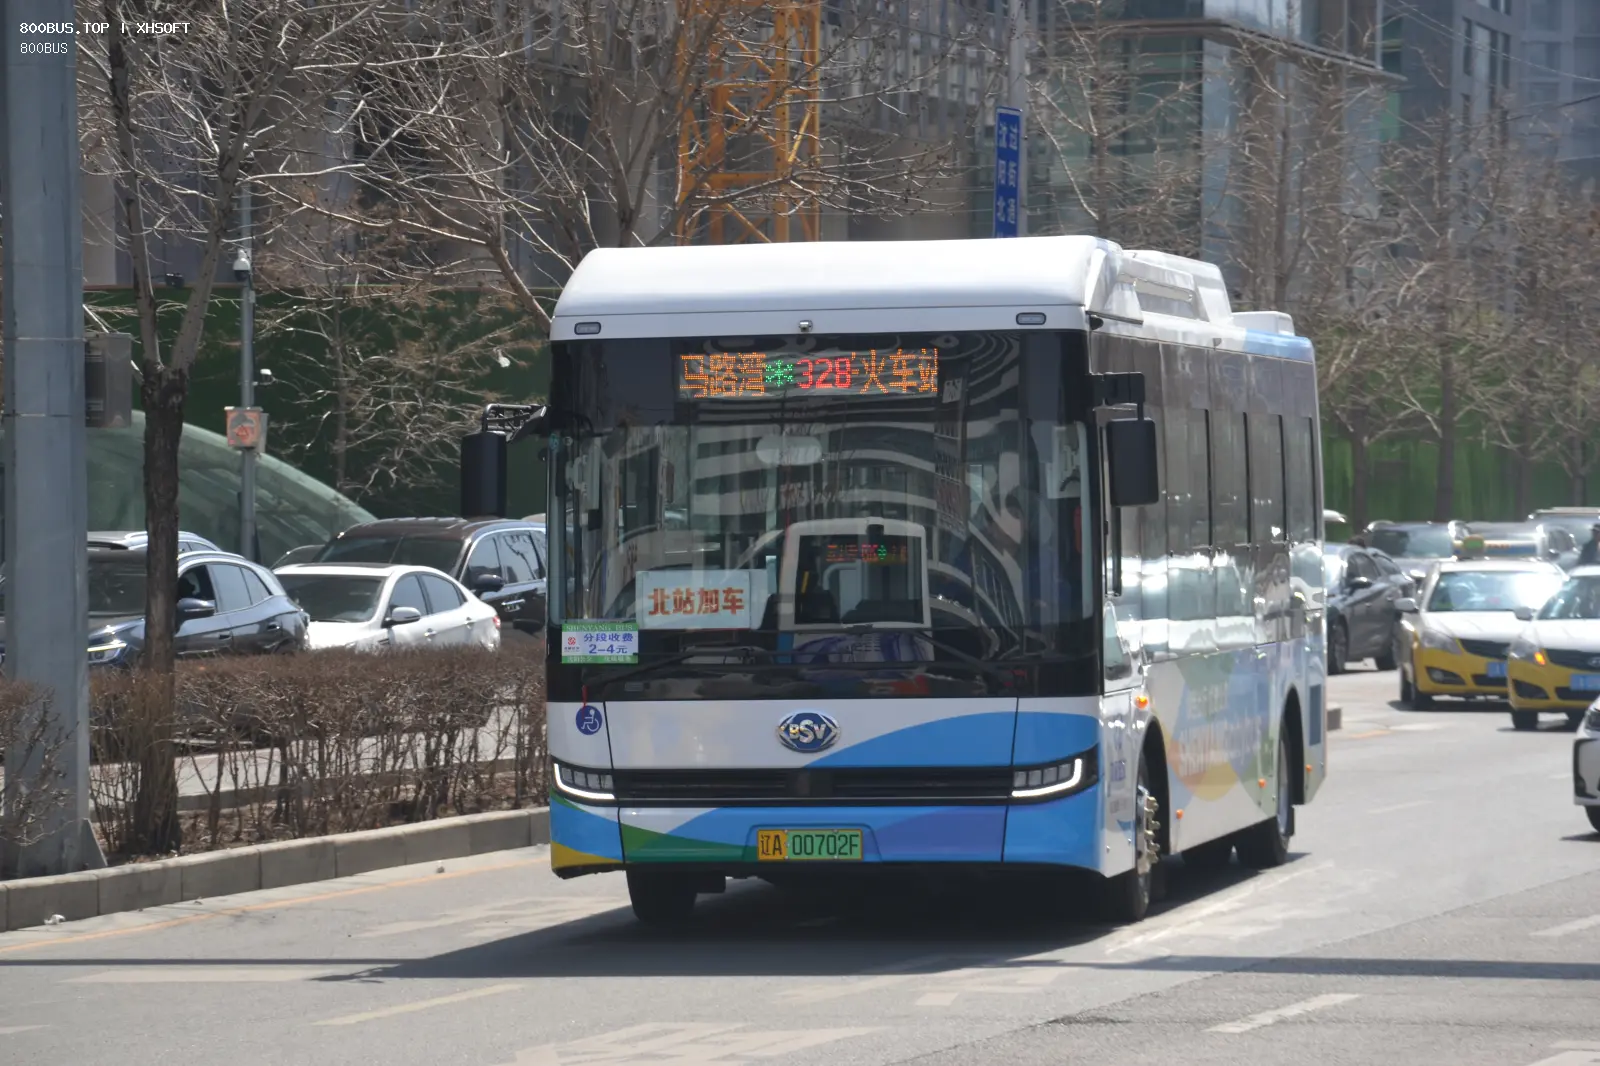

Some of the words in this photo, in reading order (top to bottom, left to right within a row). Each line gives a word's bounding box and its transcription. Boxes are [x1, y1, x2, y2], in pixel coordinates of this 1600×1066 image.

[679, 352, 767, 398] 马路湾
[796, 358, 851, 389] 328
[583, 633, 634, 643] 分段收费
[588, 643, 628, 654] 2-4元
[789, 719, 827, 744] BSV
[792, 834, 860, 856] 00702F
